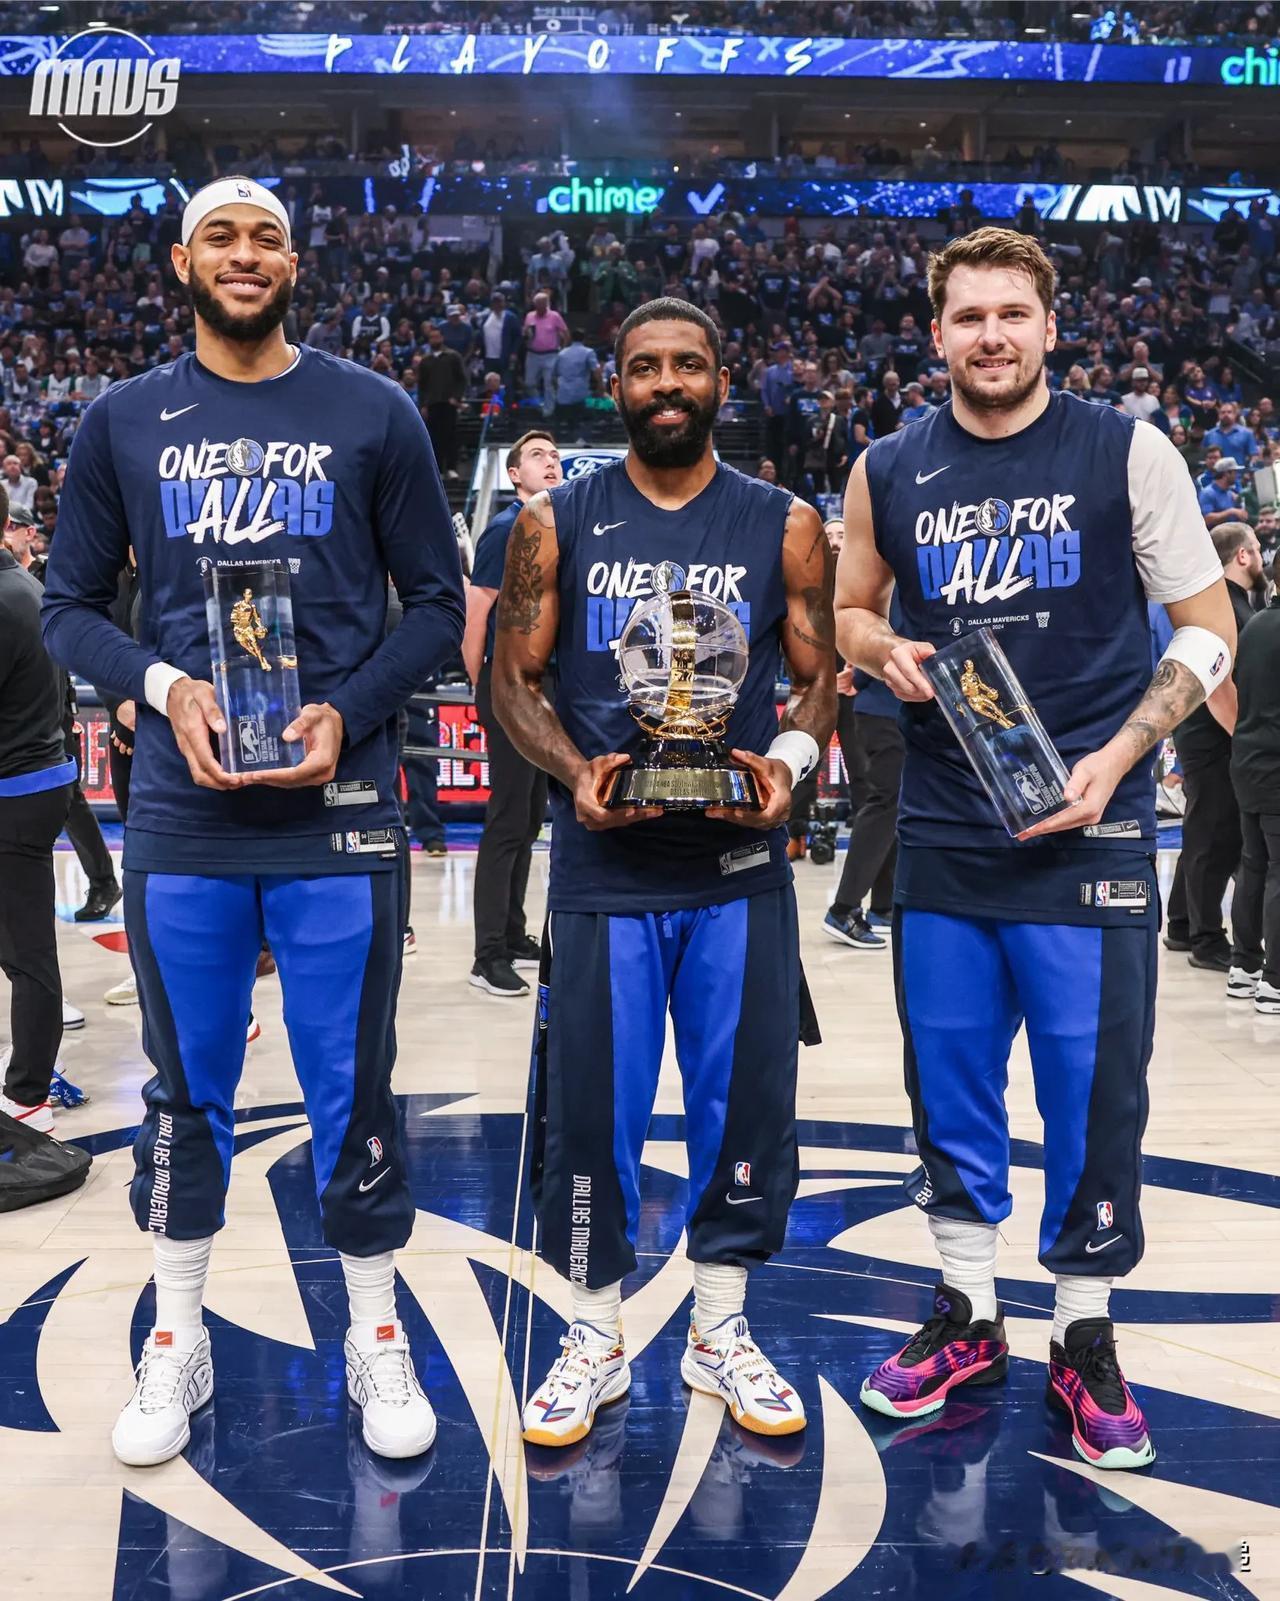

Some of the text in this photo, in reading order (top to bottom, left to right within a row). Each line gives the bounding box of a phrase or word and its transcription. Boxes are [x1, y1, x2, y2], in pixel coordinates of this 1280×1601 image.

[1220, 46, 1280, 86] chi
[547, 176, 659, 214] chime
[158, 437, 333, 486] ONE FOR
[186, 477, 286, 545] ALL
[915, 493, 1076, 547] ONE FOR
[586, 556, 748, 605] ONE FOR
[940, 537, 1034, 605] ALL
[967, 614, 1030, 626] DALLAS MAVERICKS
[148, 1111, 173, 1236] DALLAS MAVERIC
[572, 1174, 592, 1224] DALLAS
